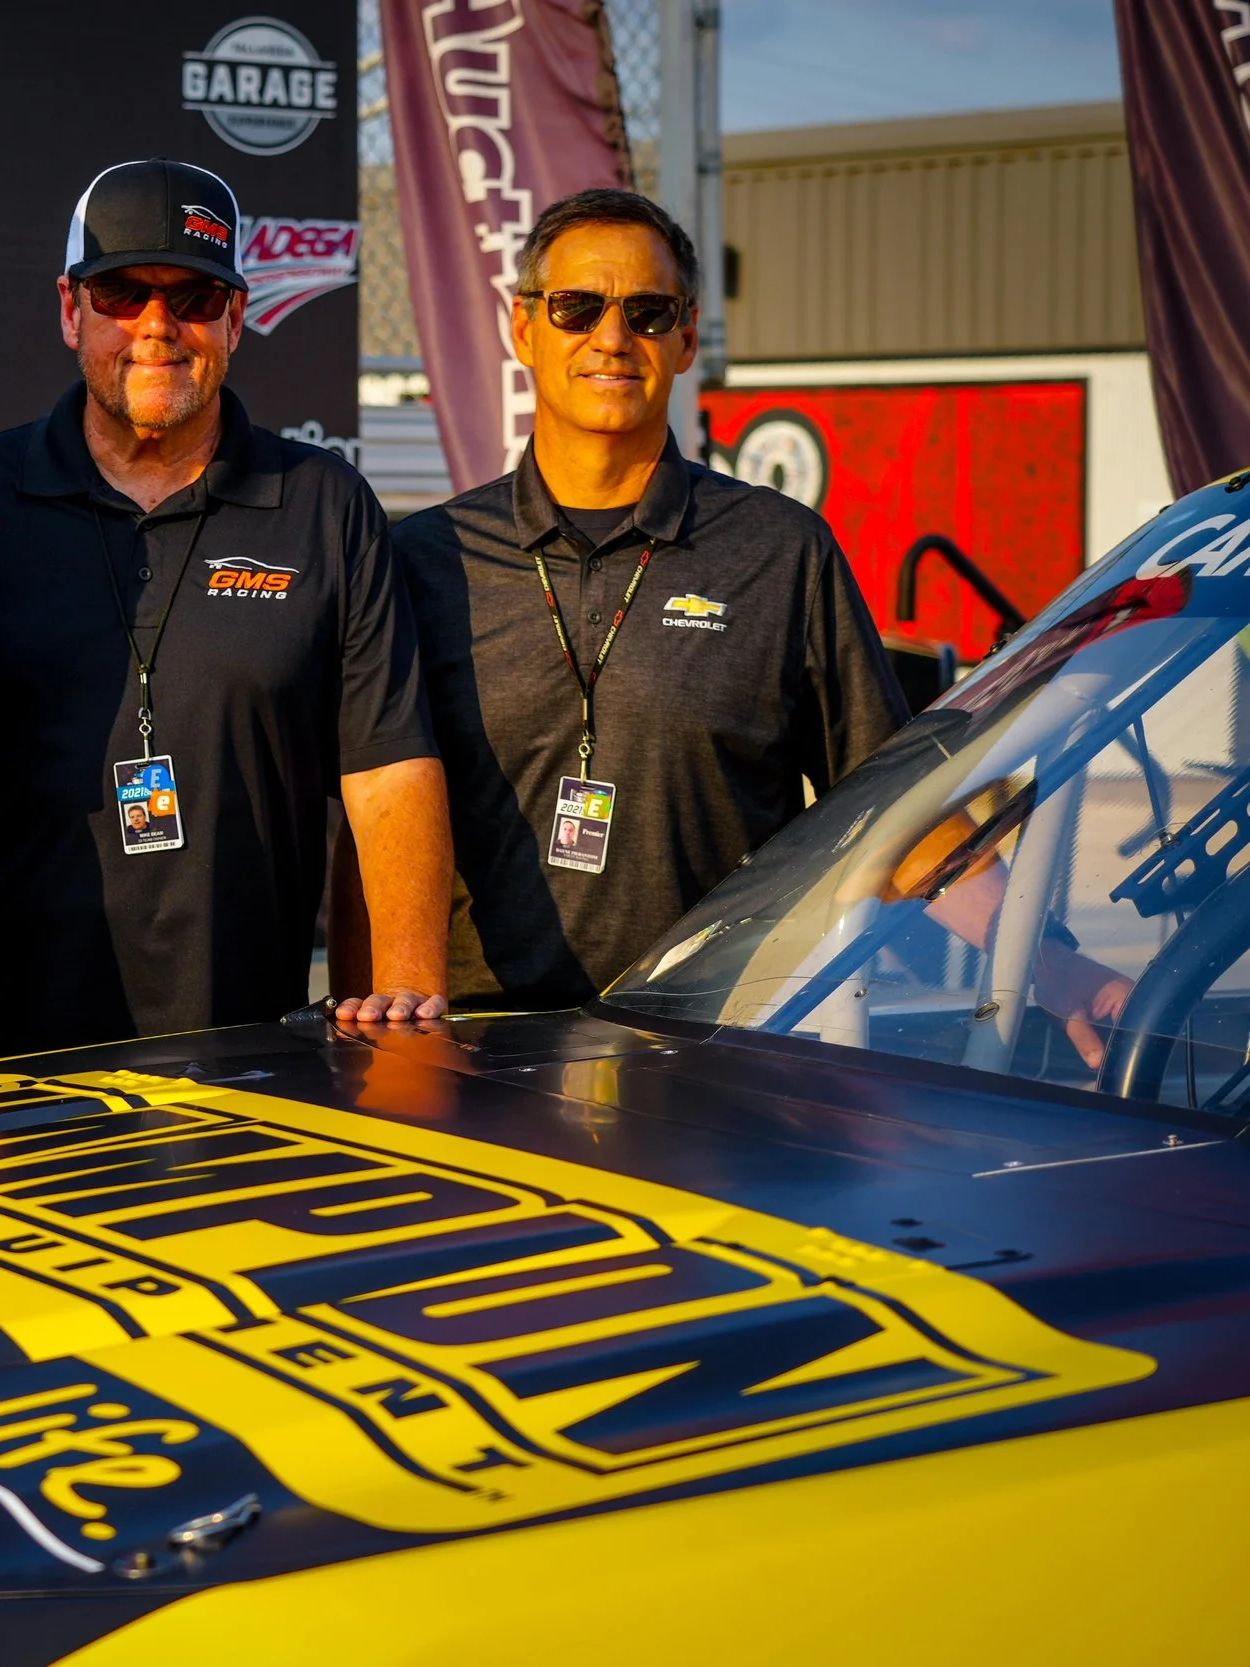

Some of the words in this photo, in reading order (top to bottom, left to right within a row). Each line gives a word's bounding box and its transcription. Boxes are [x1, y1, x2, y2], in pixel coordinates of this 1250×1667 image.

[181, 60, 338, 109] GARAGE
[183, 228, 228, 249] RACING
[185, 215, 228, 242] GMS
[208, 569, 292, 592] GMS
[624, 564, 643, 604] CHEVROLET
[207, 587, 288, 600] RACING
[662, 617, 728, 633] CHEVROLET
[597, 625, 617, 666] CHEVROLET
[150, 768, 163, 788] E
[122, 788, 143, 798] 2021
[560, 802, 582, 814] 2021
[587, 797, 603, 818] E
[582, 829, 604, 838] Premier
